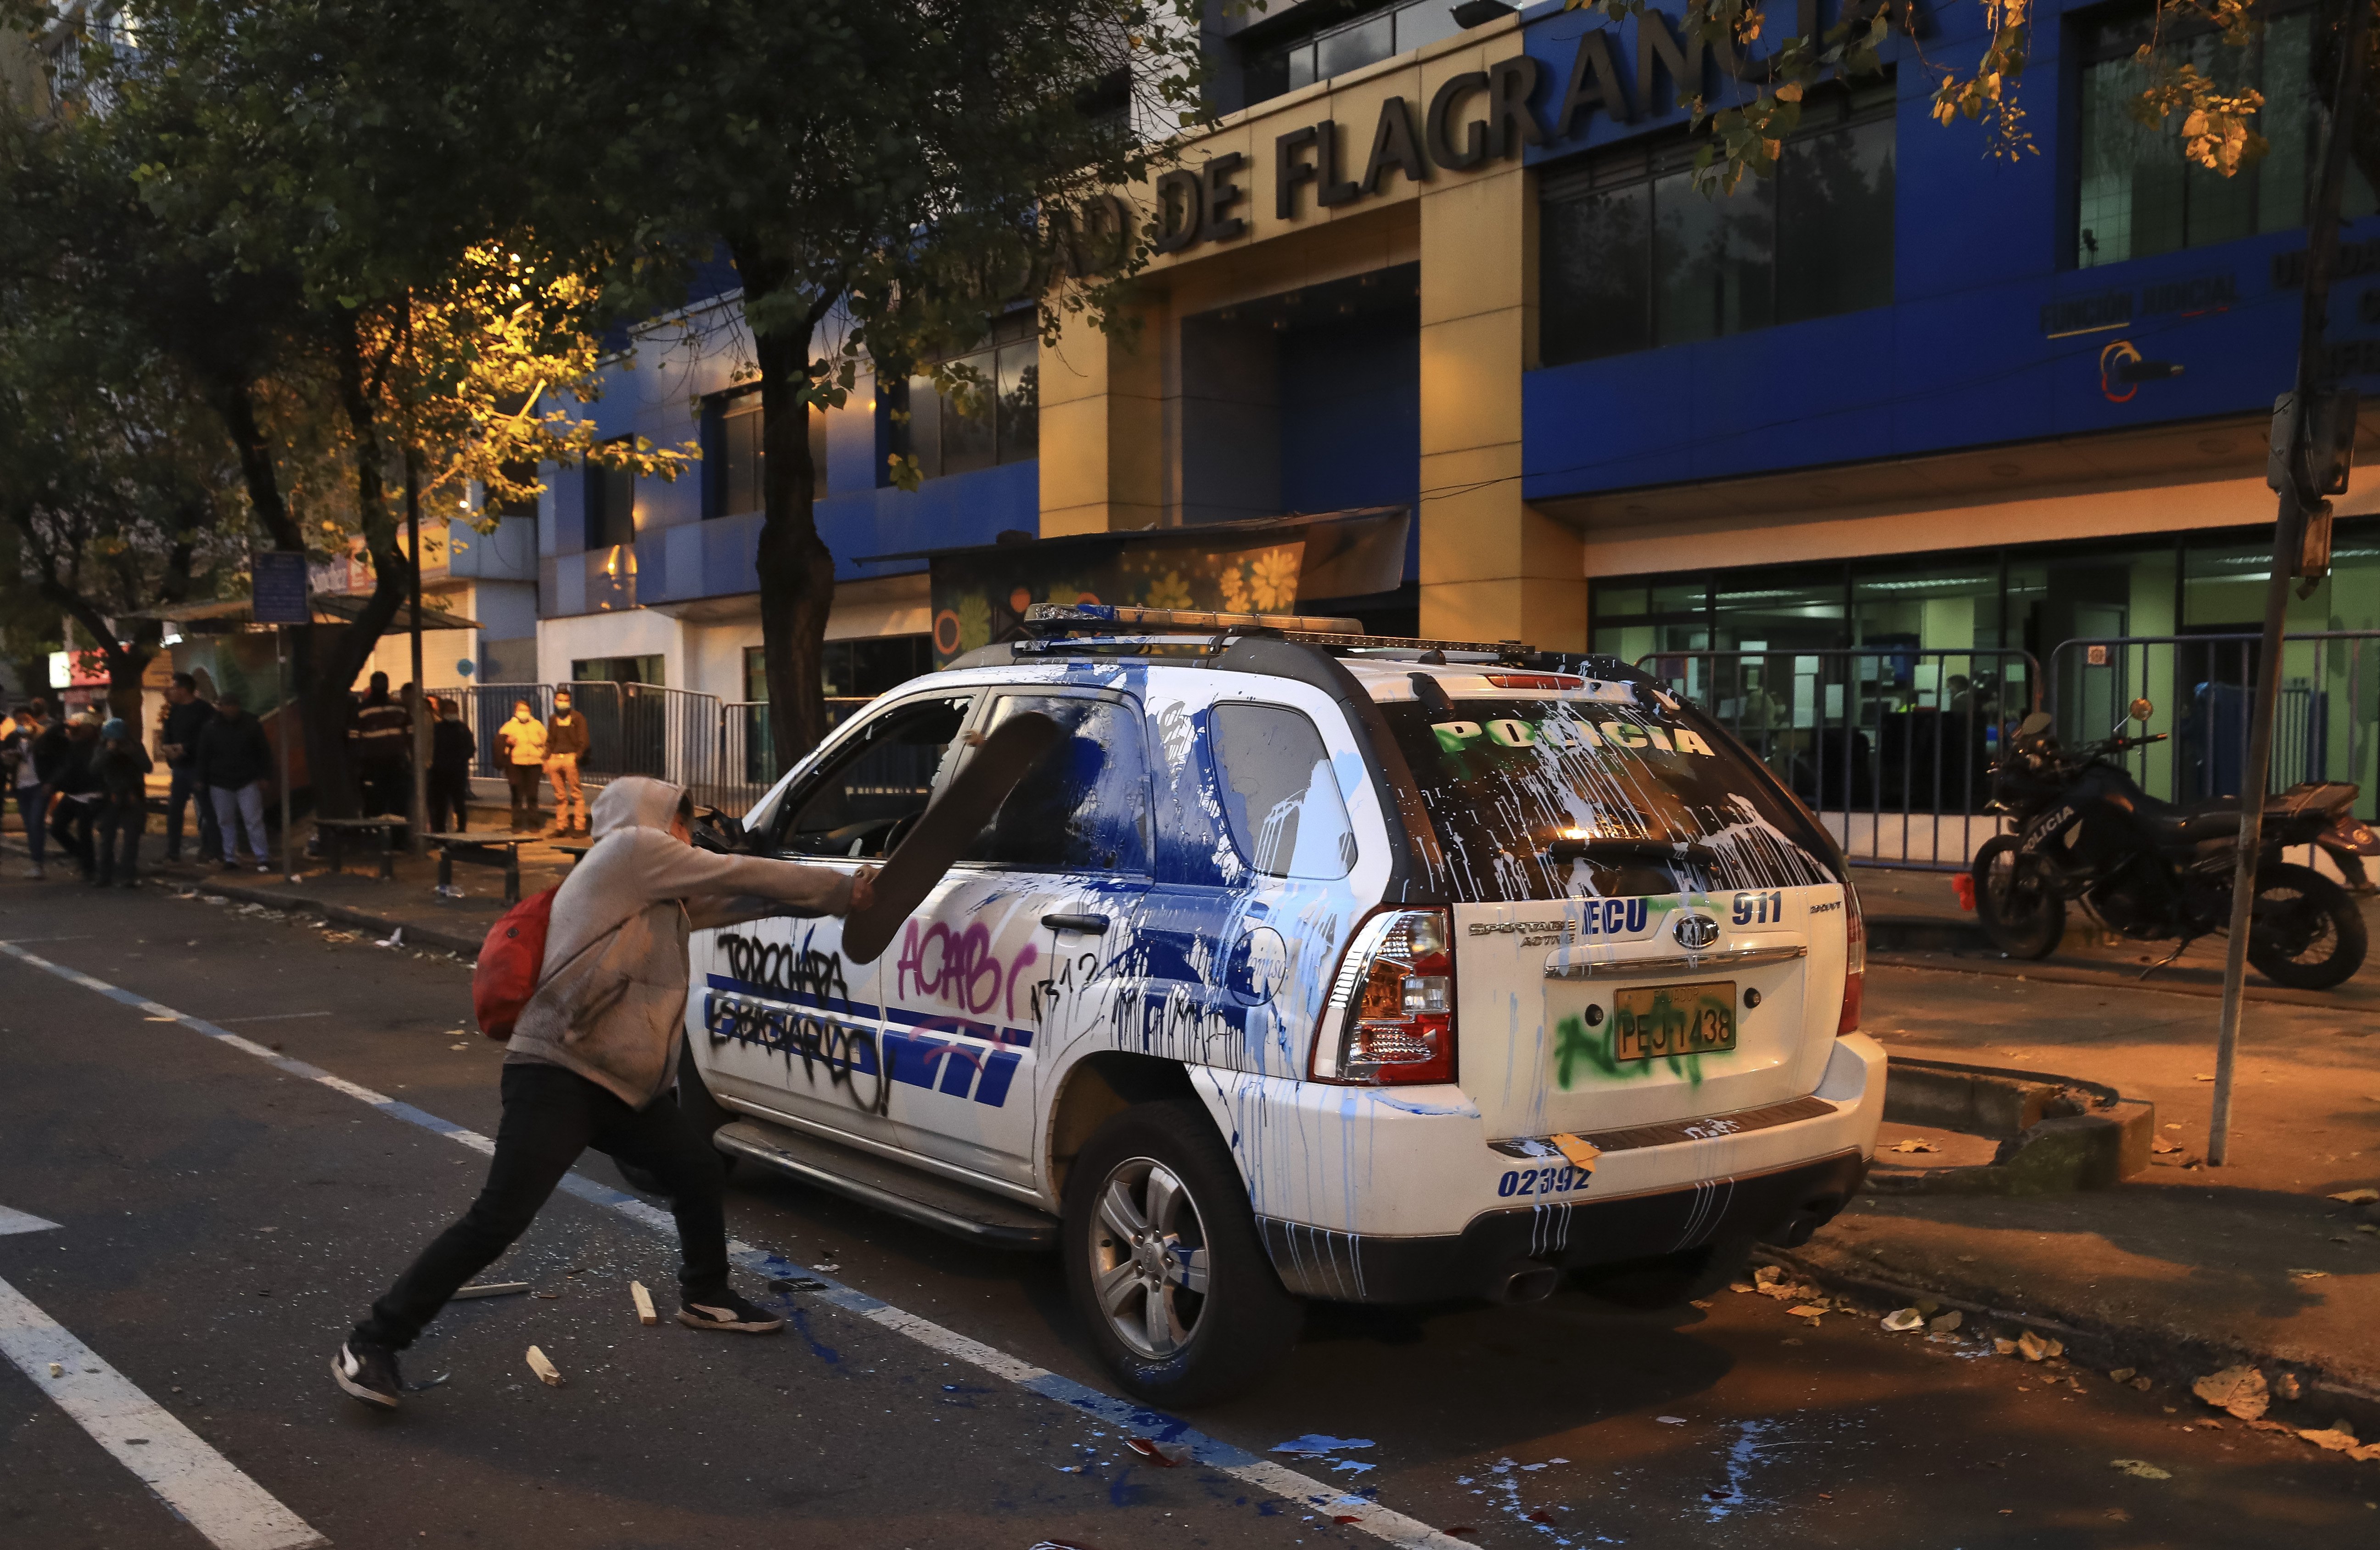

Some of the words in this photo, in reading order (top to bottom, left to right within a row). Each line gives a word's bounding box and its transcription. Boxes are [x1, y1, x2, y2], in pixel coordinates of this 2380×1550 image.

[1156, 152, 1244, 255] DE
[1469, 919, 1577, 937] SPORTAGE
[1582, 899, 1648, 935] ECU
[1732, 891, 1781, 926] 911
[1679, 921, 1719, 946] KIA
[1498, 1165, 1593, 1197] 02392
